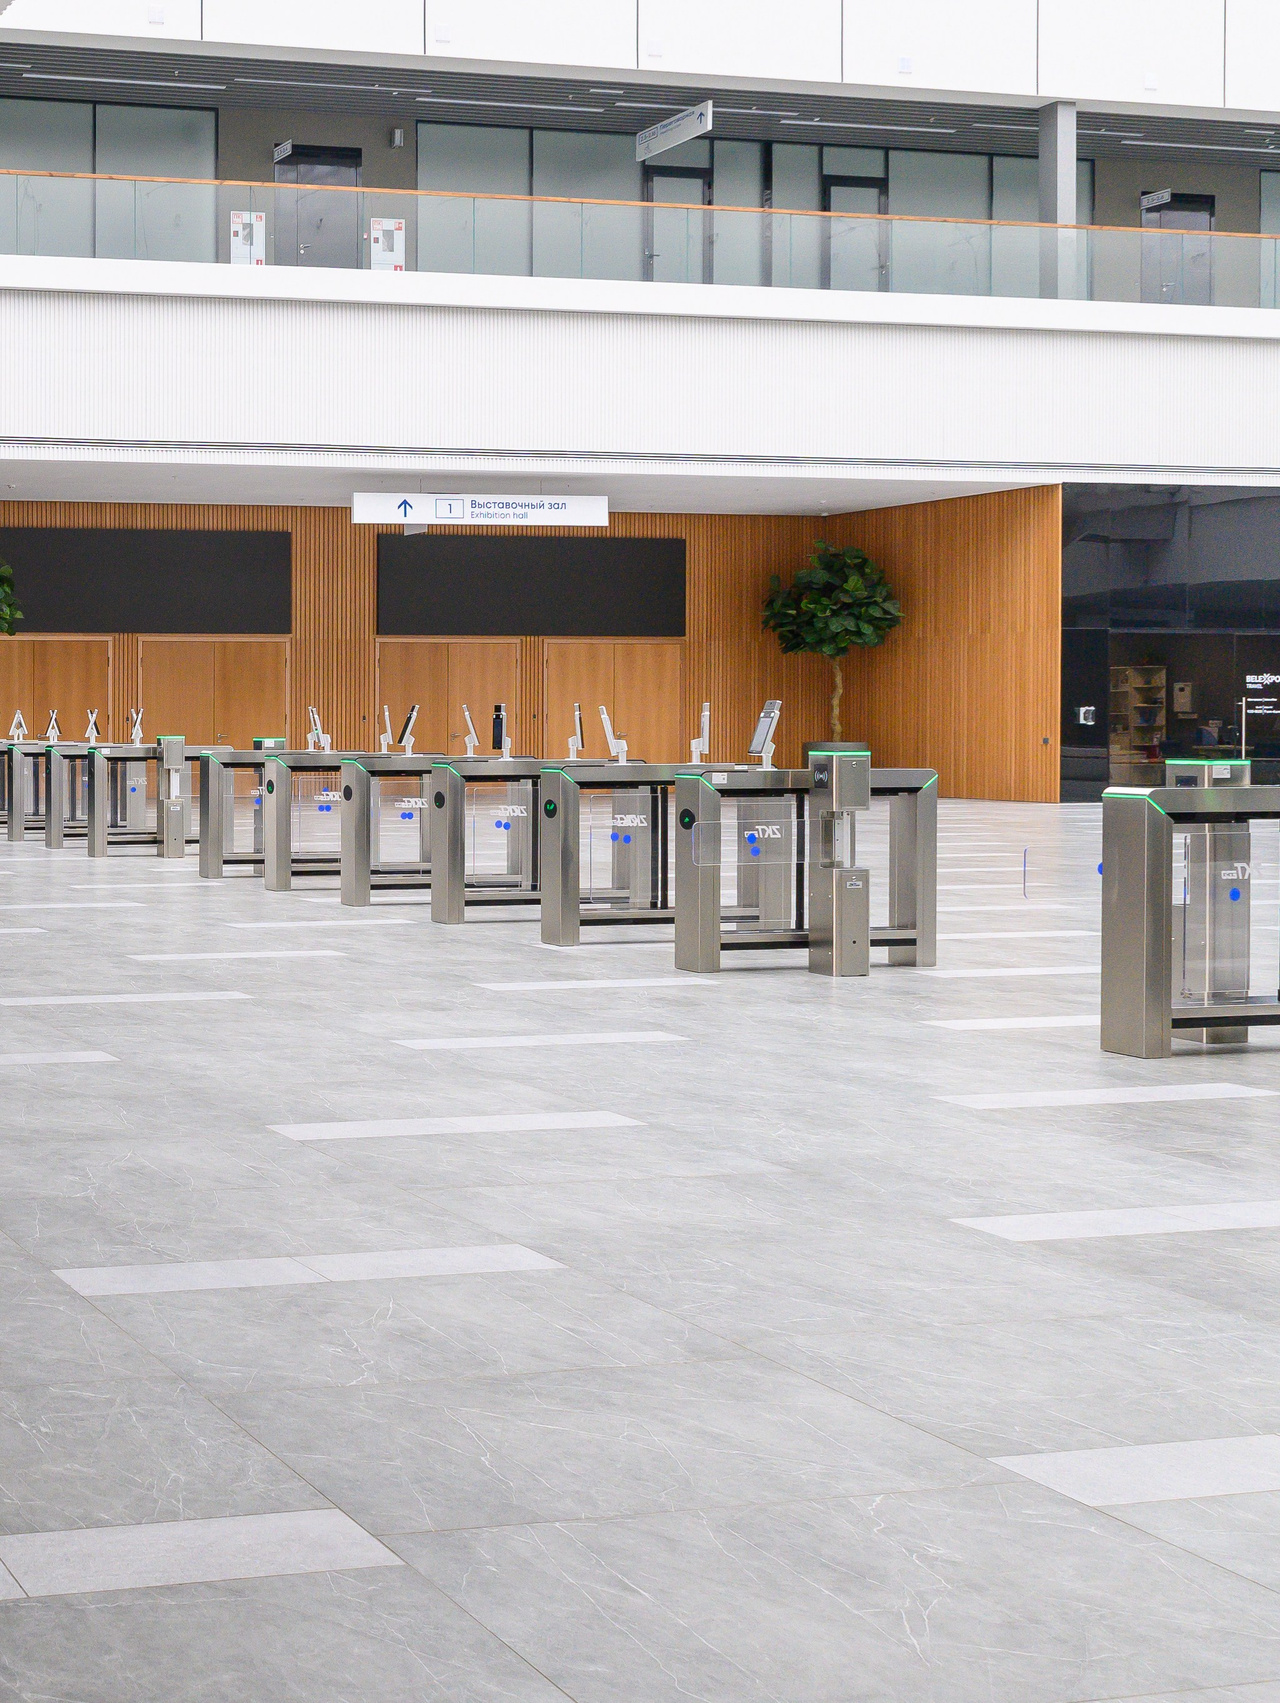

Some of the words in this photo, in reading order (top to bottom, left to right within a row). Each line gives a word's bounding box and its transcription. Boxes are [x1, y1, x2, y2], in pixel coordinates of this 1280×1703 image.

[448, 503, 452, 514] 1
[470, 499, 545, 510] Выставочный
[547, 502, 567, 510] зал
[470, 511, 511, 519] Exhibition
[513, 511, 528, 519] hall
